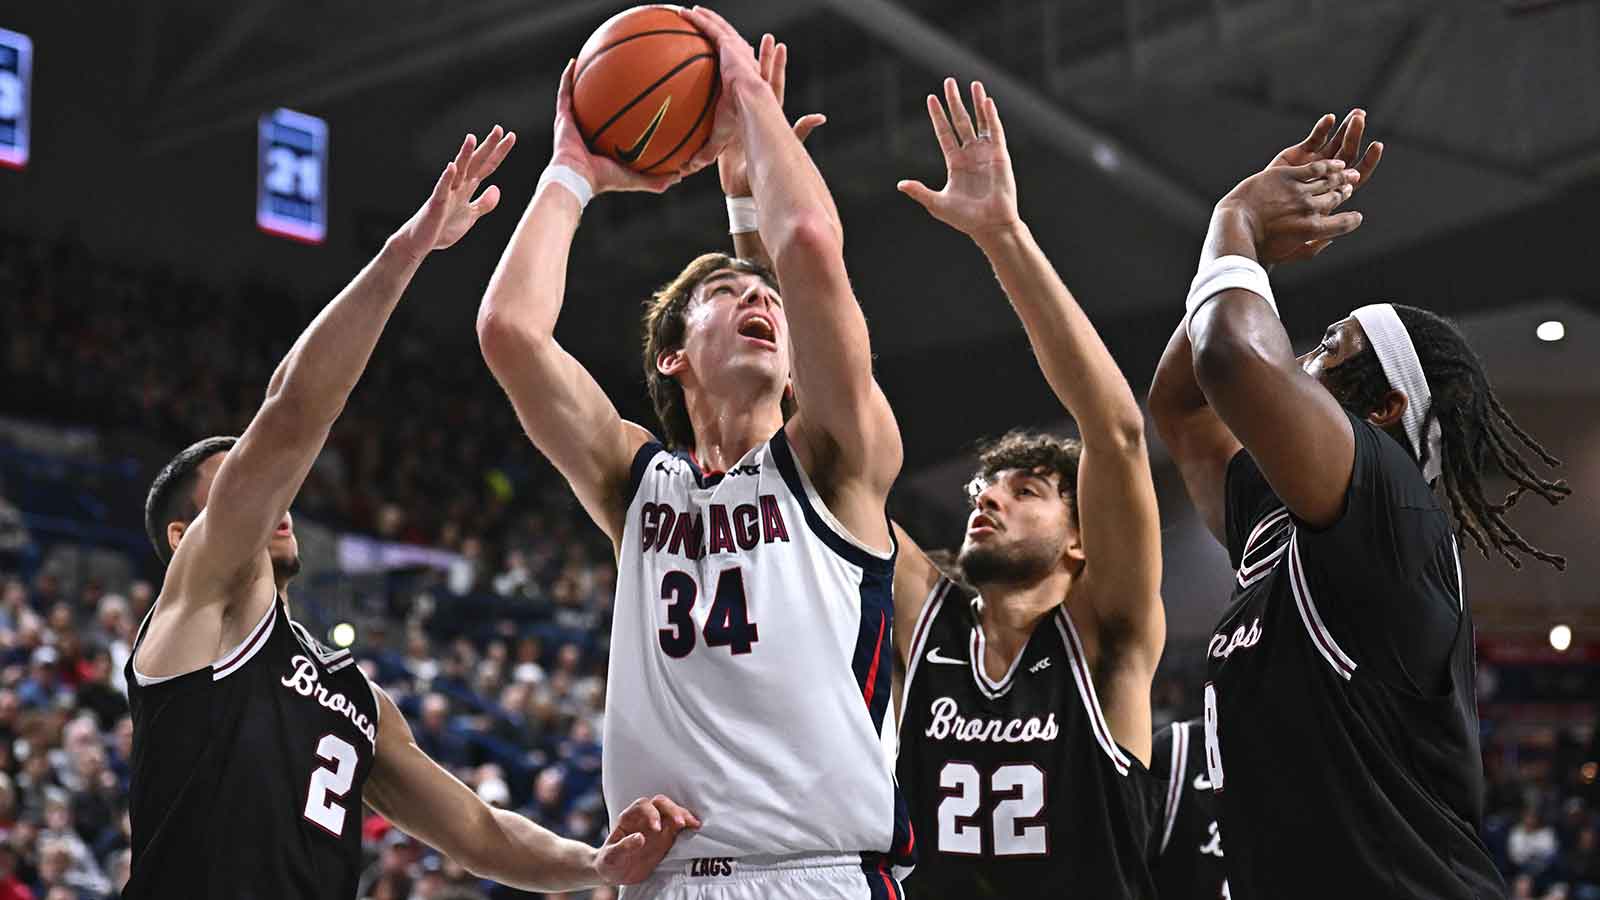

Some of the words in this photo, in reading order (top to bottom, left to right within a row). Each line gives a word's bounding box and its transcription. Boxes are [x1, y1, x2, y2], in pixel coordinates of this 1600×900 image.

[658, 566, 760, 659] 34
[281, 654, 377, 756] Bronco
[925, 696, 1059, 743] Broncos
[303, 733, 359, 837] 2
[937, 761, 1047, 856] 22
